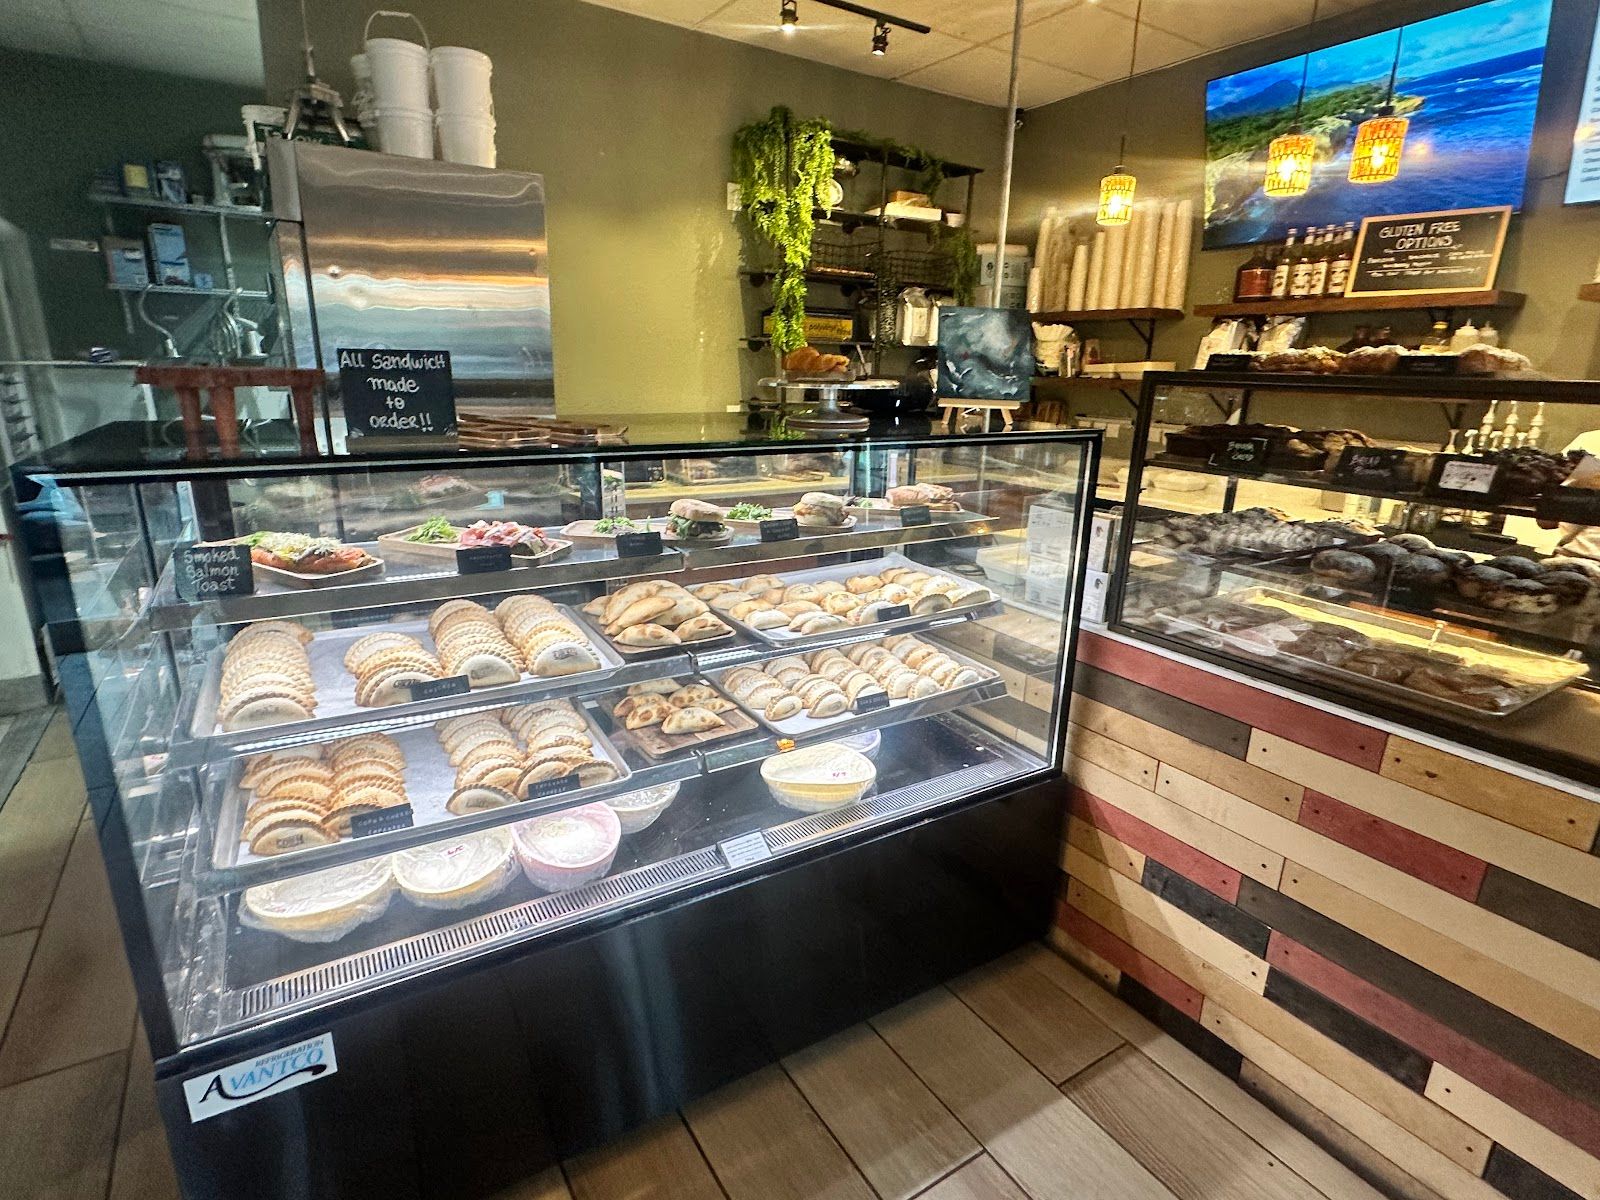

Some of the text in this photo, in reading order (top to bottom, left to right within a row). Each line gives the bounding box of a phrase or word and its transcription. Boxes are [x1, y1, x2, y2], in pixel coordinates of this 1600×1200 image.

[1379, 221, 1461, 239] GLUTEN FREE
[1396, 235, 1453, 250] OPTIONS
[367, 377, 420, 393] made
[184, 547, 240, 563] Smoked
[186, 563, 240, 579] Salmon
[191, 577, 236, 592] Toast
[199, 1048, 327, 1103] AVANTCO
